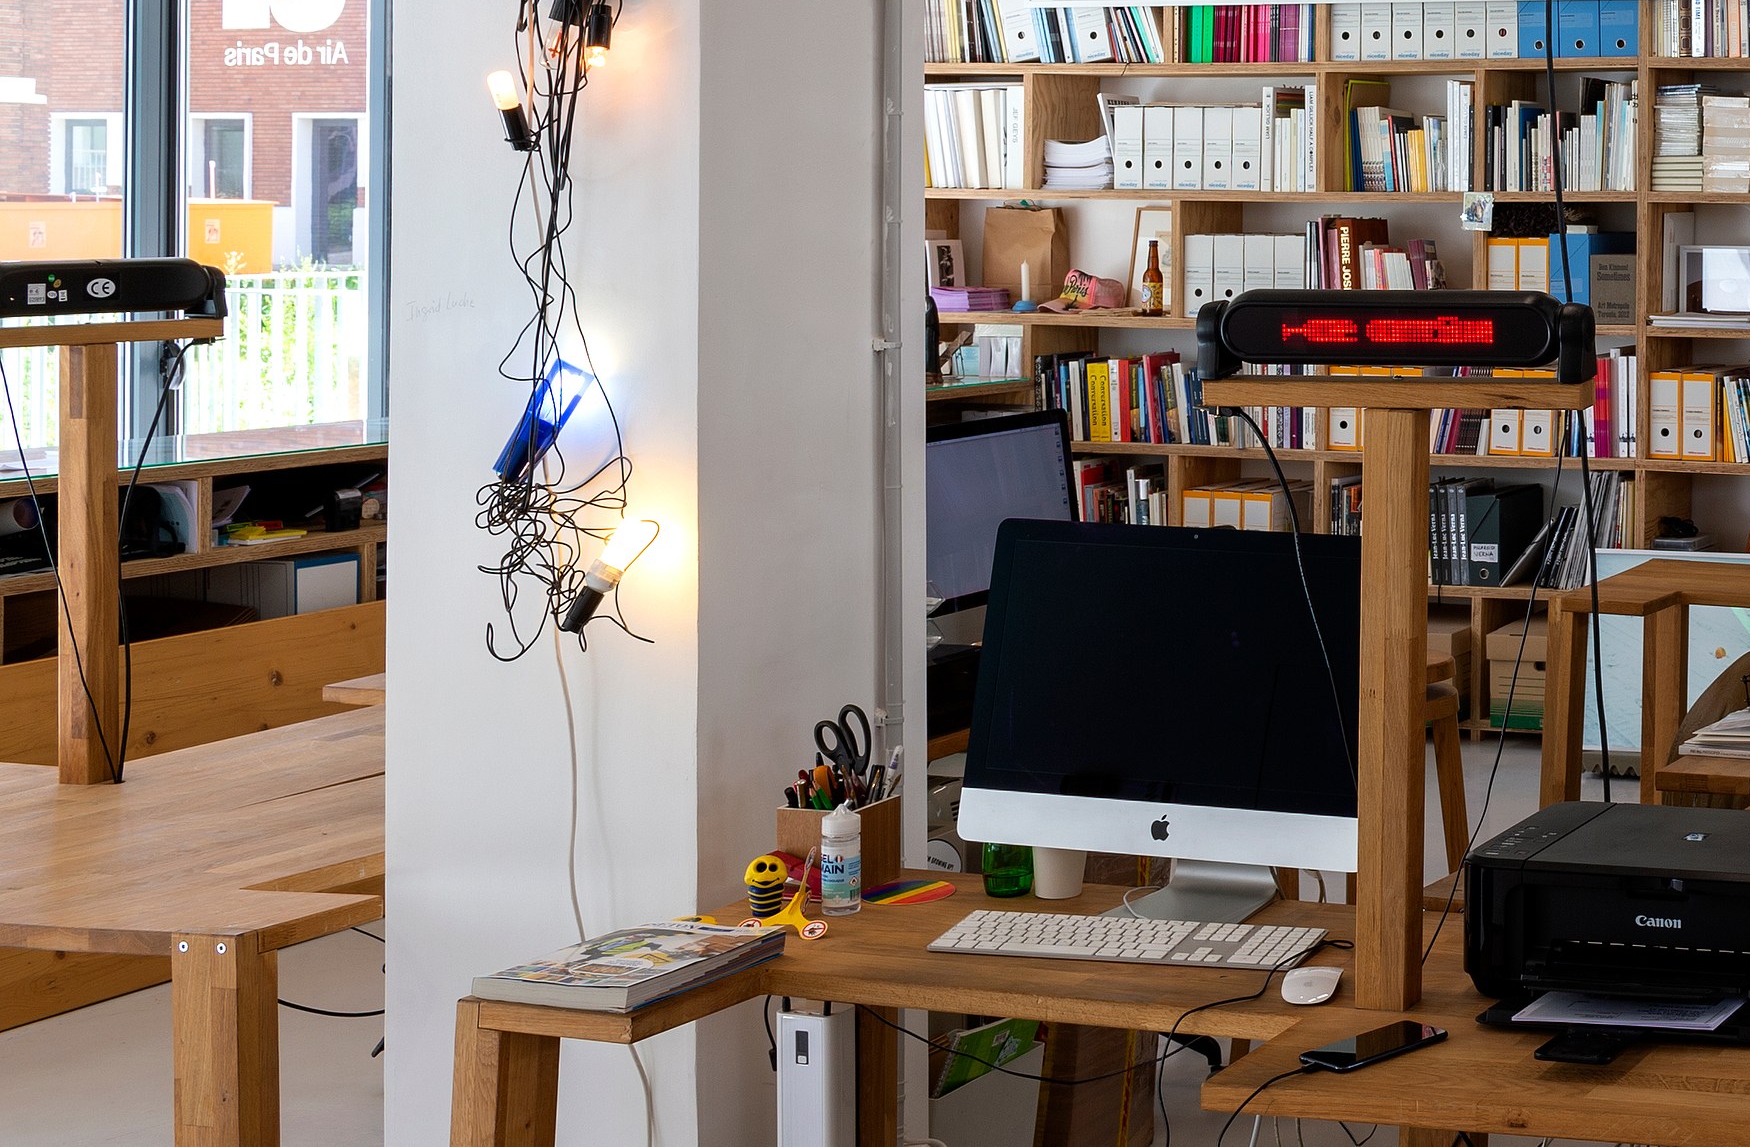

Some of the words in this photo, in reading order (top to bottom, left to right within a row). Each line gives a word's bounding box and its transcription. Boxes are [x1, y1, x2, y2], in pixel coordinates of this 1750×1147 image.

[1340, 226, 1351, 264] PIERRE
[1597, 271, 1631, 282] Sometimes
[1099, 374, 1107, 427] Conversation
[1429, 513, 1437, 532] Verna
[1449, 513, 1457, 532] Verna
[1458, 513, 1466, 532] Verna
[1430, 533, 1438, 560] Jean-Luc
[1450, 533, 1458, 560] Jean-Luc
[1459, 533, 1467, 560] Jean-Luc
[1635, 914, 1682, 930] Canon
